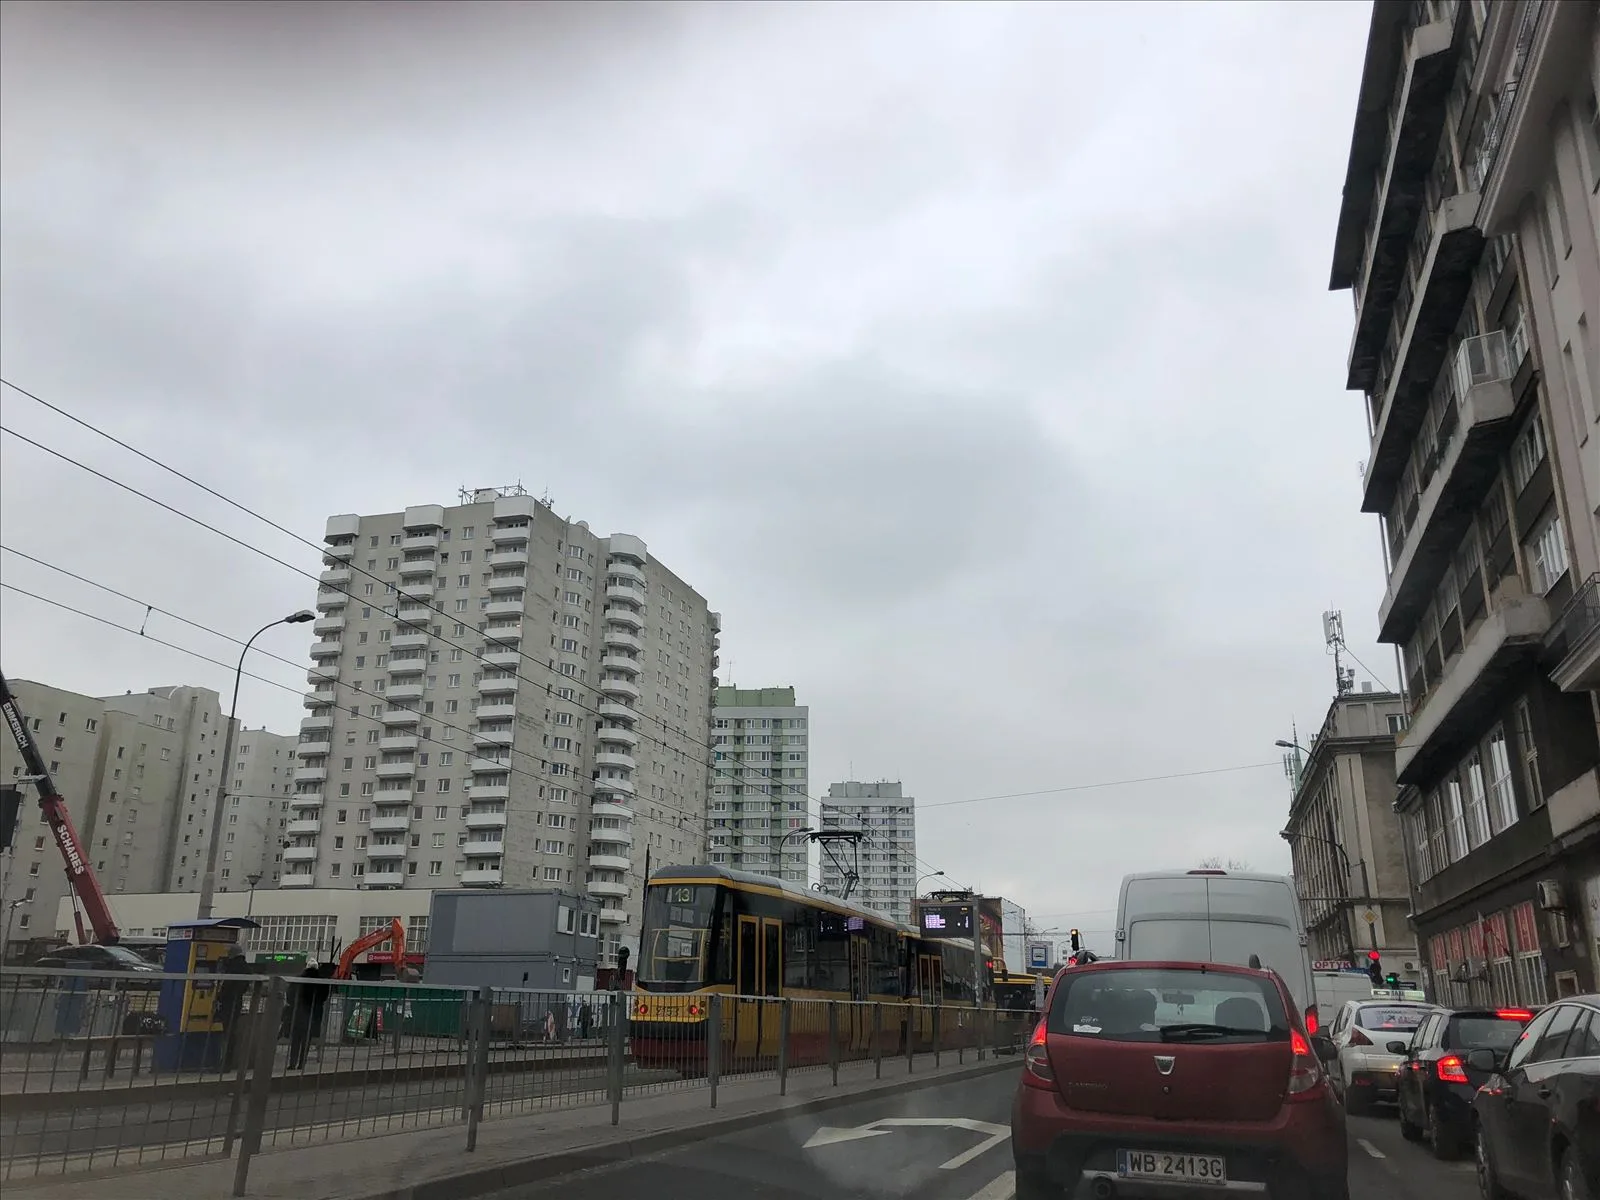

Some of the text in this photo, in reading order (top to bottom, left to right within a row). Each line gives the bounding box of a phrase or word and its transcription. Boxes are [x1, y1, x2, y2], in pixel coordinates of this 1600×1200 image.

[57, 824, 84, 875] SCHARES
[675, 888, 690, 902] 13
[1130, 1153, 1222, 1178] WB 2413G
